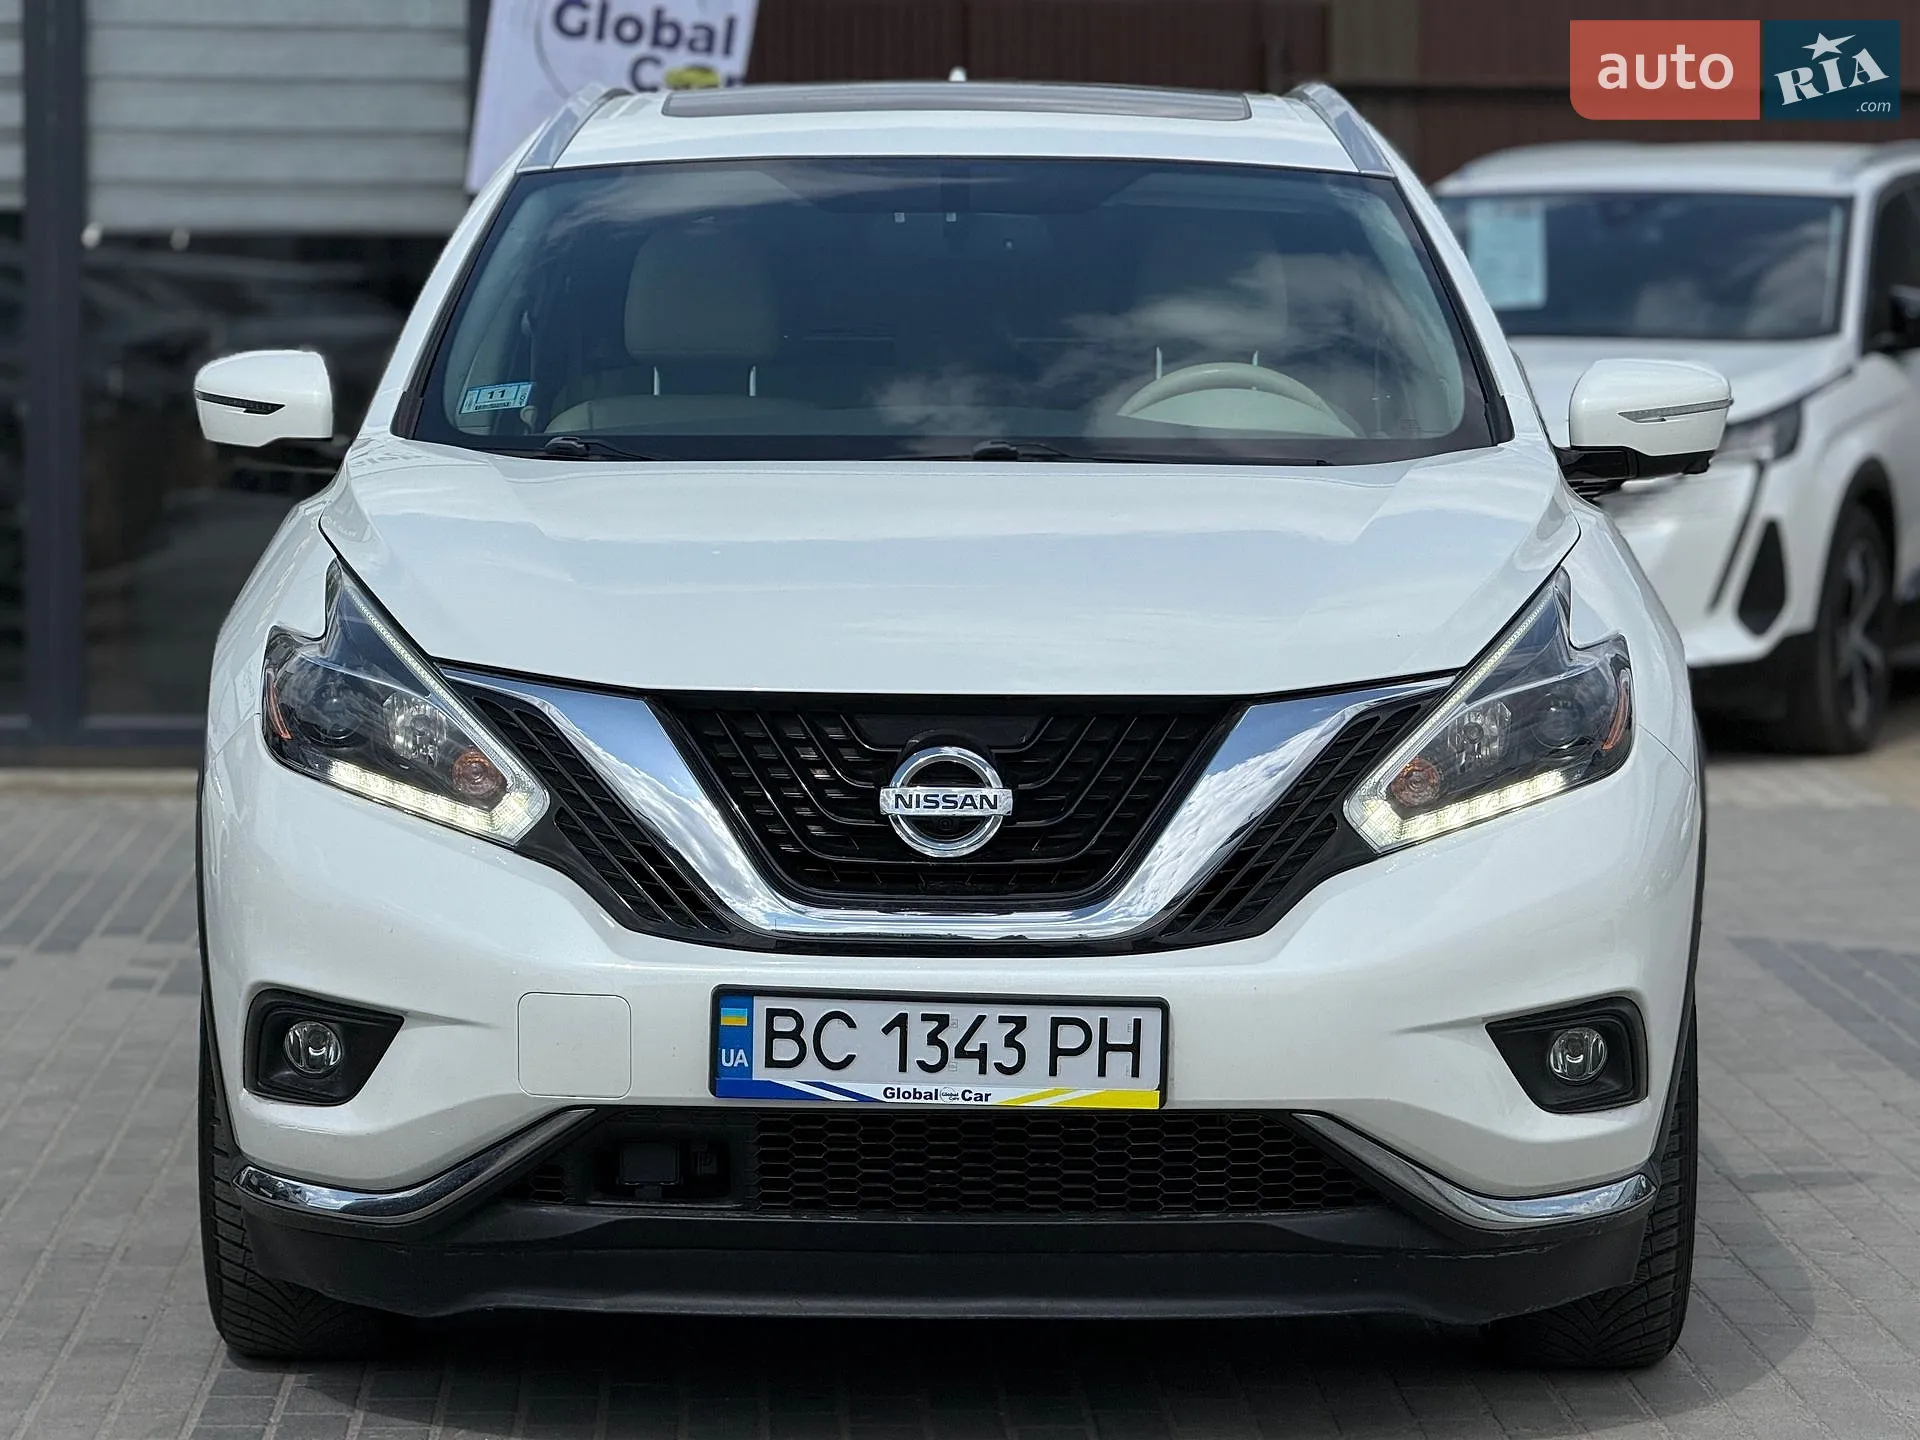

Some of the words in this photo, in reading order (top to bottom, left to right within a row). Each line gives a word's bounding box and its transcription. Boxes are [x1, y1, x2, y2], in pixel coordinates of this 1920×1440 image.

[552, 0, 736, 57] Global
[894, 793, 998, 810] NISSAN
[764, 1007, 857, 1071] BC
[880, 1012, 1028, 1076] 1343
[1048, 1015, 1141, 1078] PH
[721, 1048, 749, 1067] UA
[882, 1086, 939, 1101] Global
[960, 1088, 992, 1102] Car
